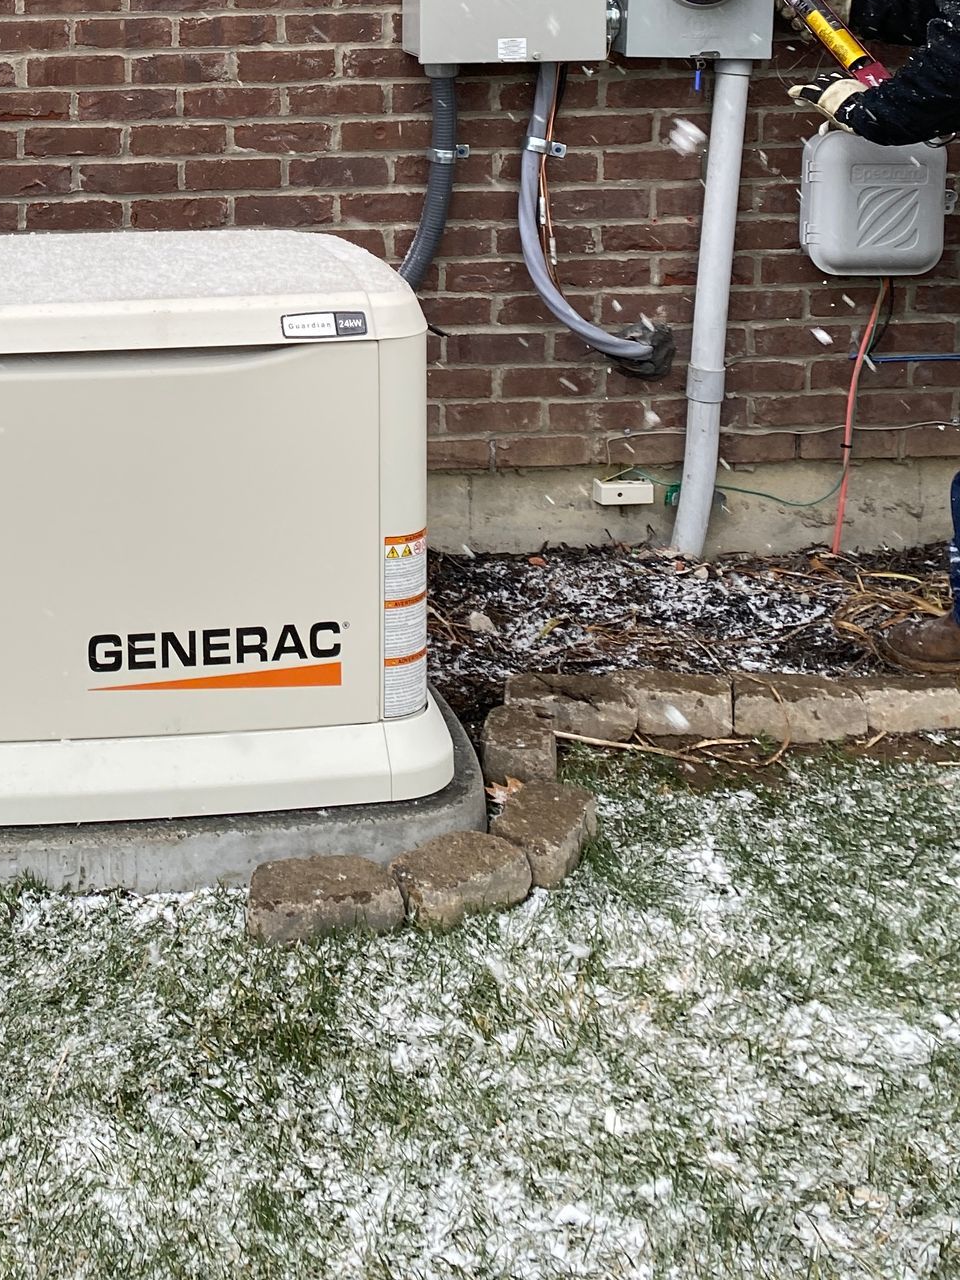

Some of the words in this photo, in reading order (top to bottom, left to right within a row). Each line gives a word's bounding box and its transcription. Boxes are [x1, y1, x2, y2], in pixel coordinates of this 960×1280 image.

[288, 322, 331, 330] Guardian
[339, 319, 362, 328] 24kW
[87, 621, 342, 673] GENERAC
